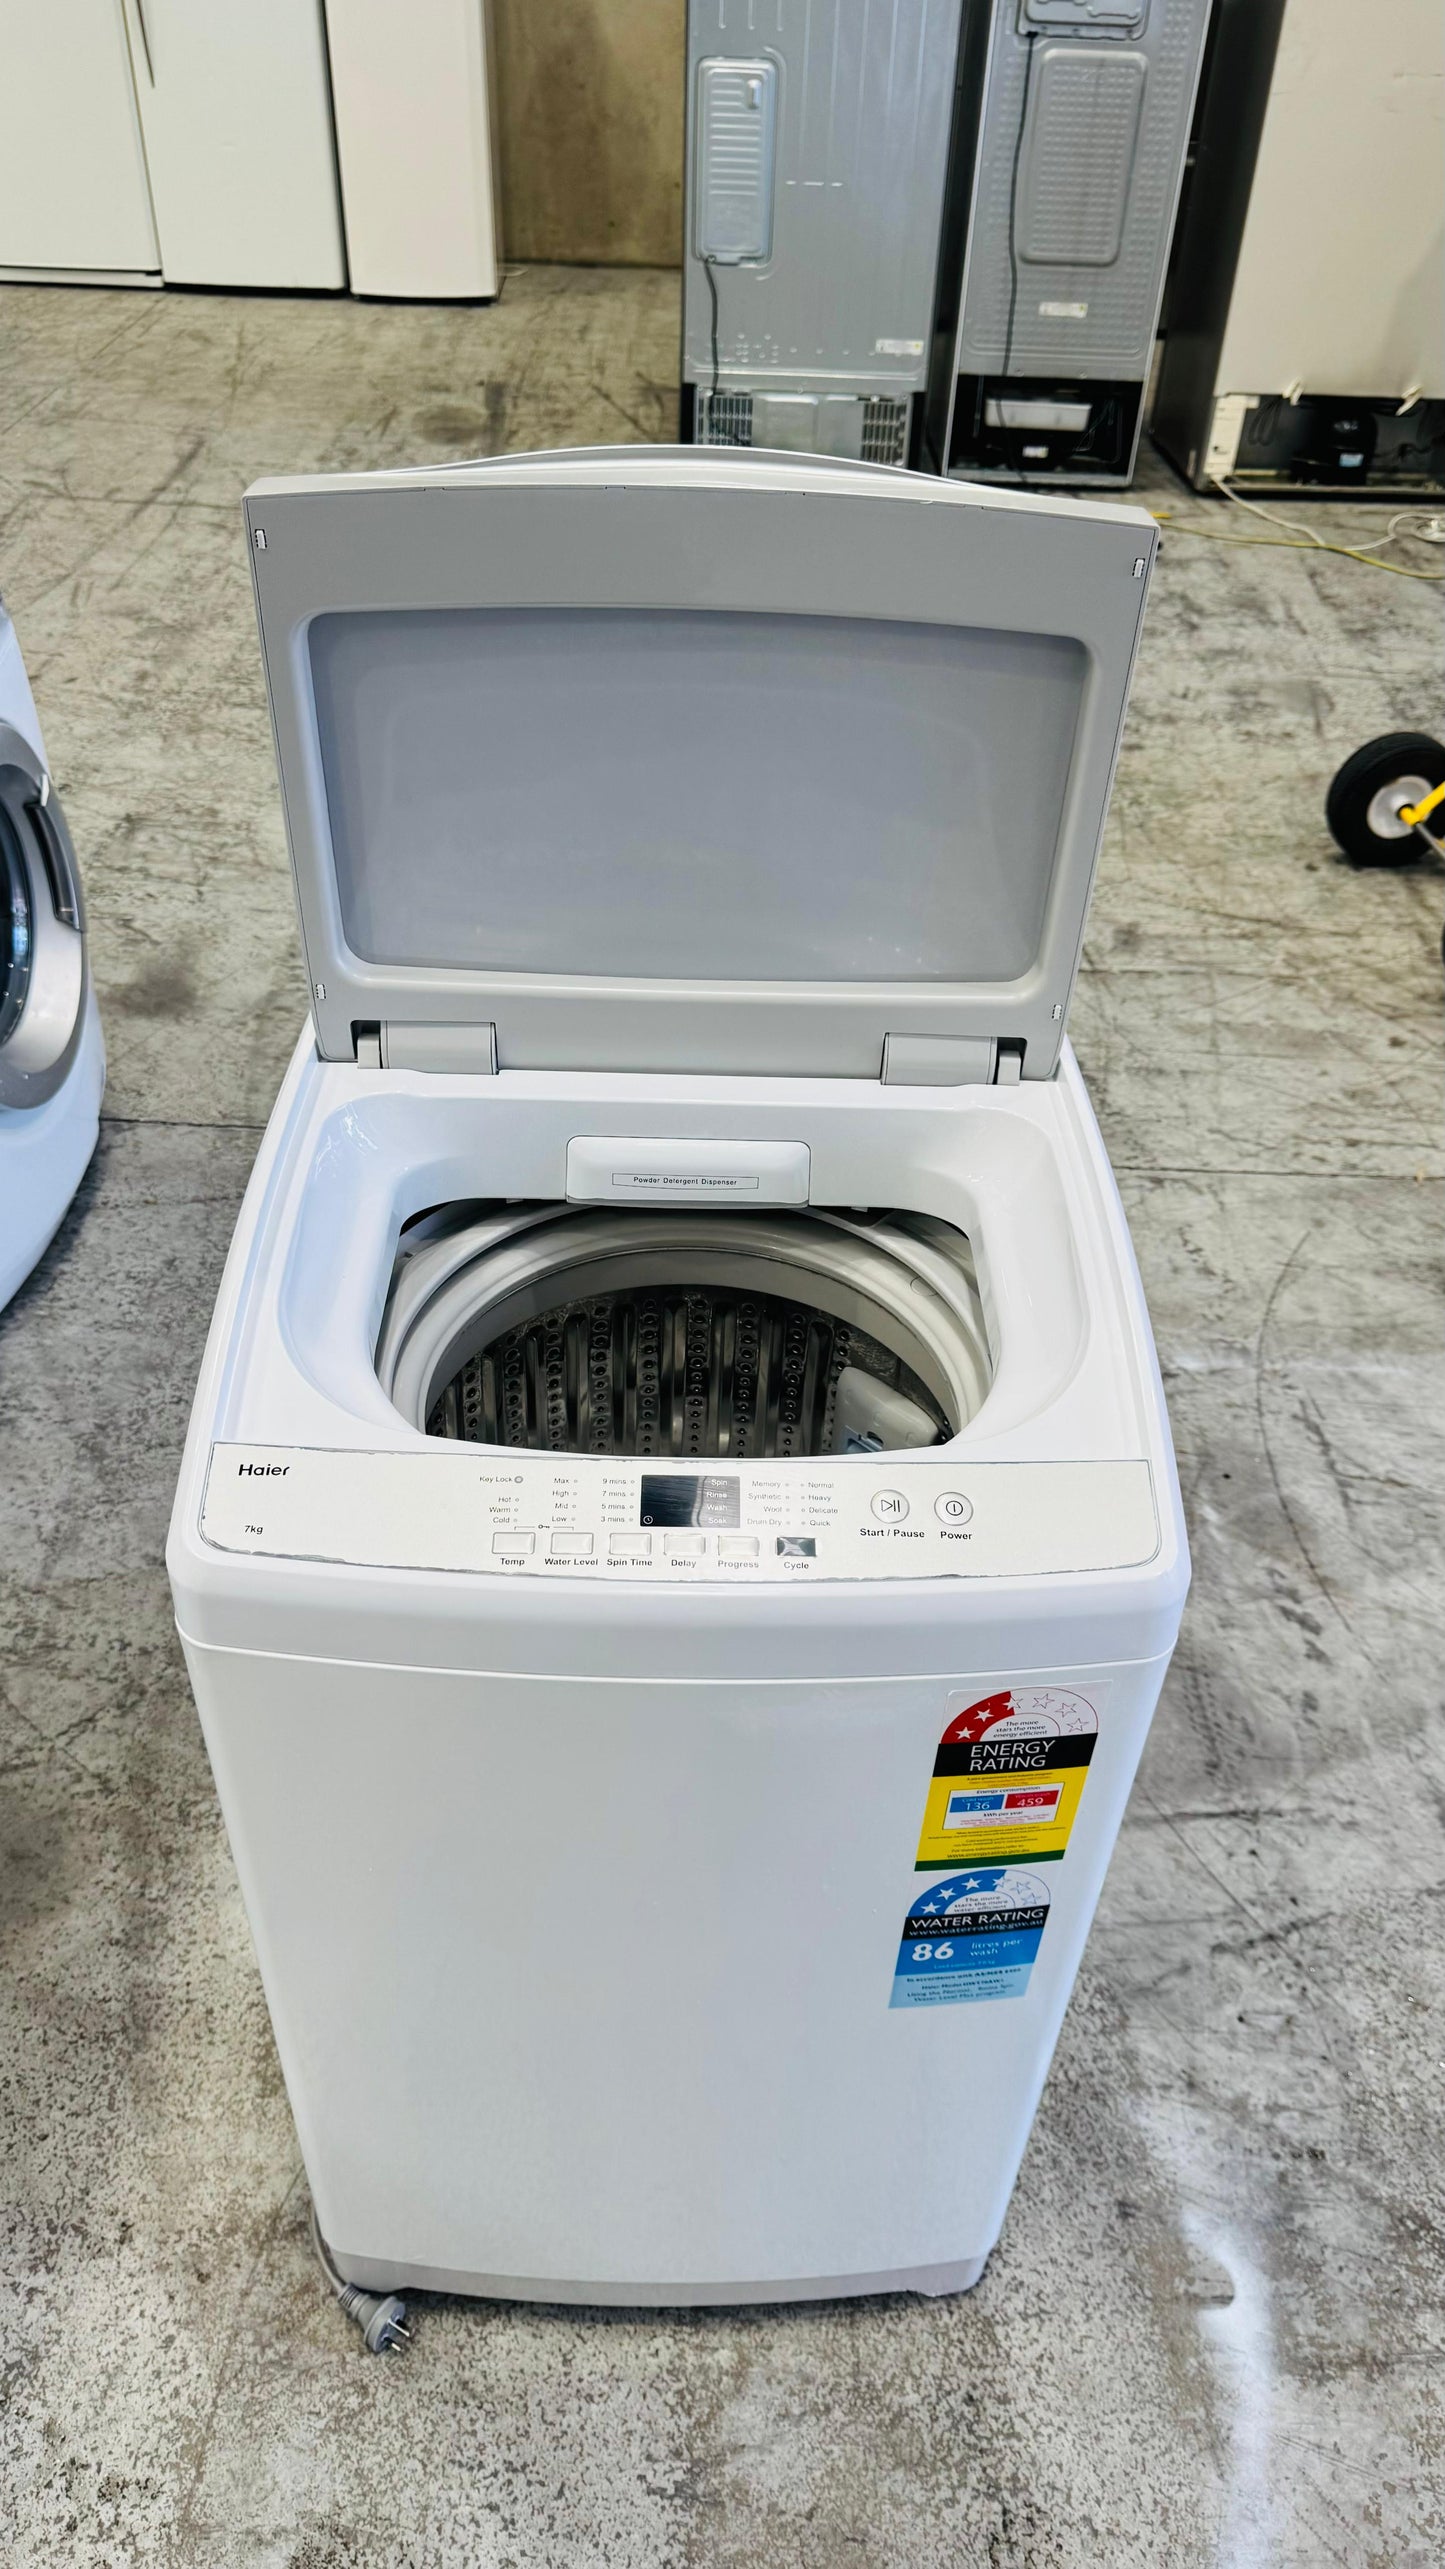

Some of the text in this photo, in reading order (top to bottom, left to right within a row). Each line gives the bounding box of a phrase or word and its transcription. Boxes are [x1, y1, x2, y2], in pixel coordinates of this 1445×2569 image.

[633, 1176, 660, 1184] Powder
[663, 1177, 698, 1186] Detergent
[239, 1464, 290, 1476] Haier
[711, 1479, 728, 1487] Spin
[808, 1494, 832, 1502] Heavy
[810, 1519, 831, 1527] Quick
[244, 1525, 263, 1535] 7kg
[860, 1528, 884, 1537] Start
[893, 1529, 925, 1538] Pause
[940, 1531, 972, 1540] Power
[500, 1558, 525, 1566] Temp
[607, 1559, 627, 1567] Spin
[671, 1559, 696, 1568] Delay
[718, 1560, 759, 1569] Progress
[784, 1561, 809, 1570] Cycle
[971, 1740, 1055, 1757] ENERGY
[969, 1755, 1046, 1771] RATING
[966, 1802, 990, 1811] 136
[1017, 1798, 1044, 1807] 459
[912, 1909, 1044, 1929] WATER RATING
[971, 1939, 1023, 1949] litres per
[912, 1942, 954, 1961] 86
[970, 1948, 998, 1956] wash
